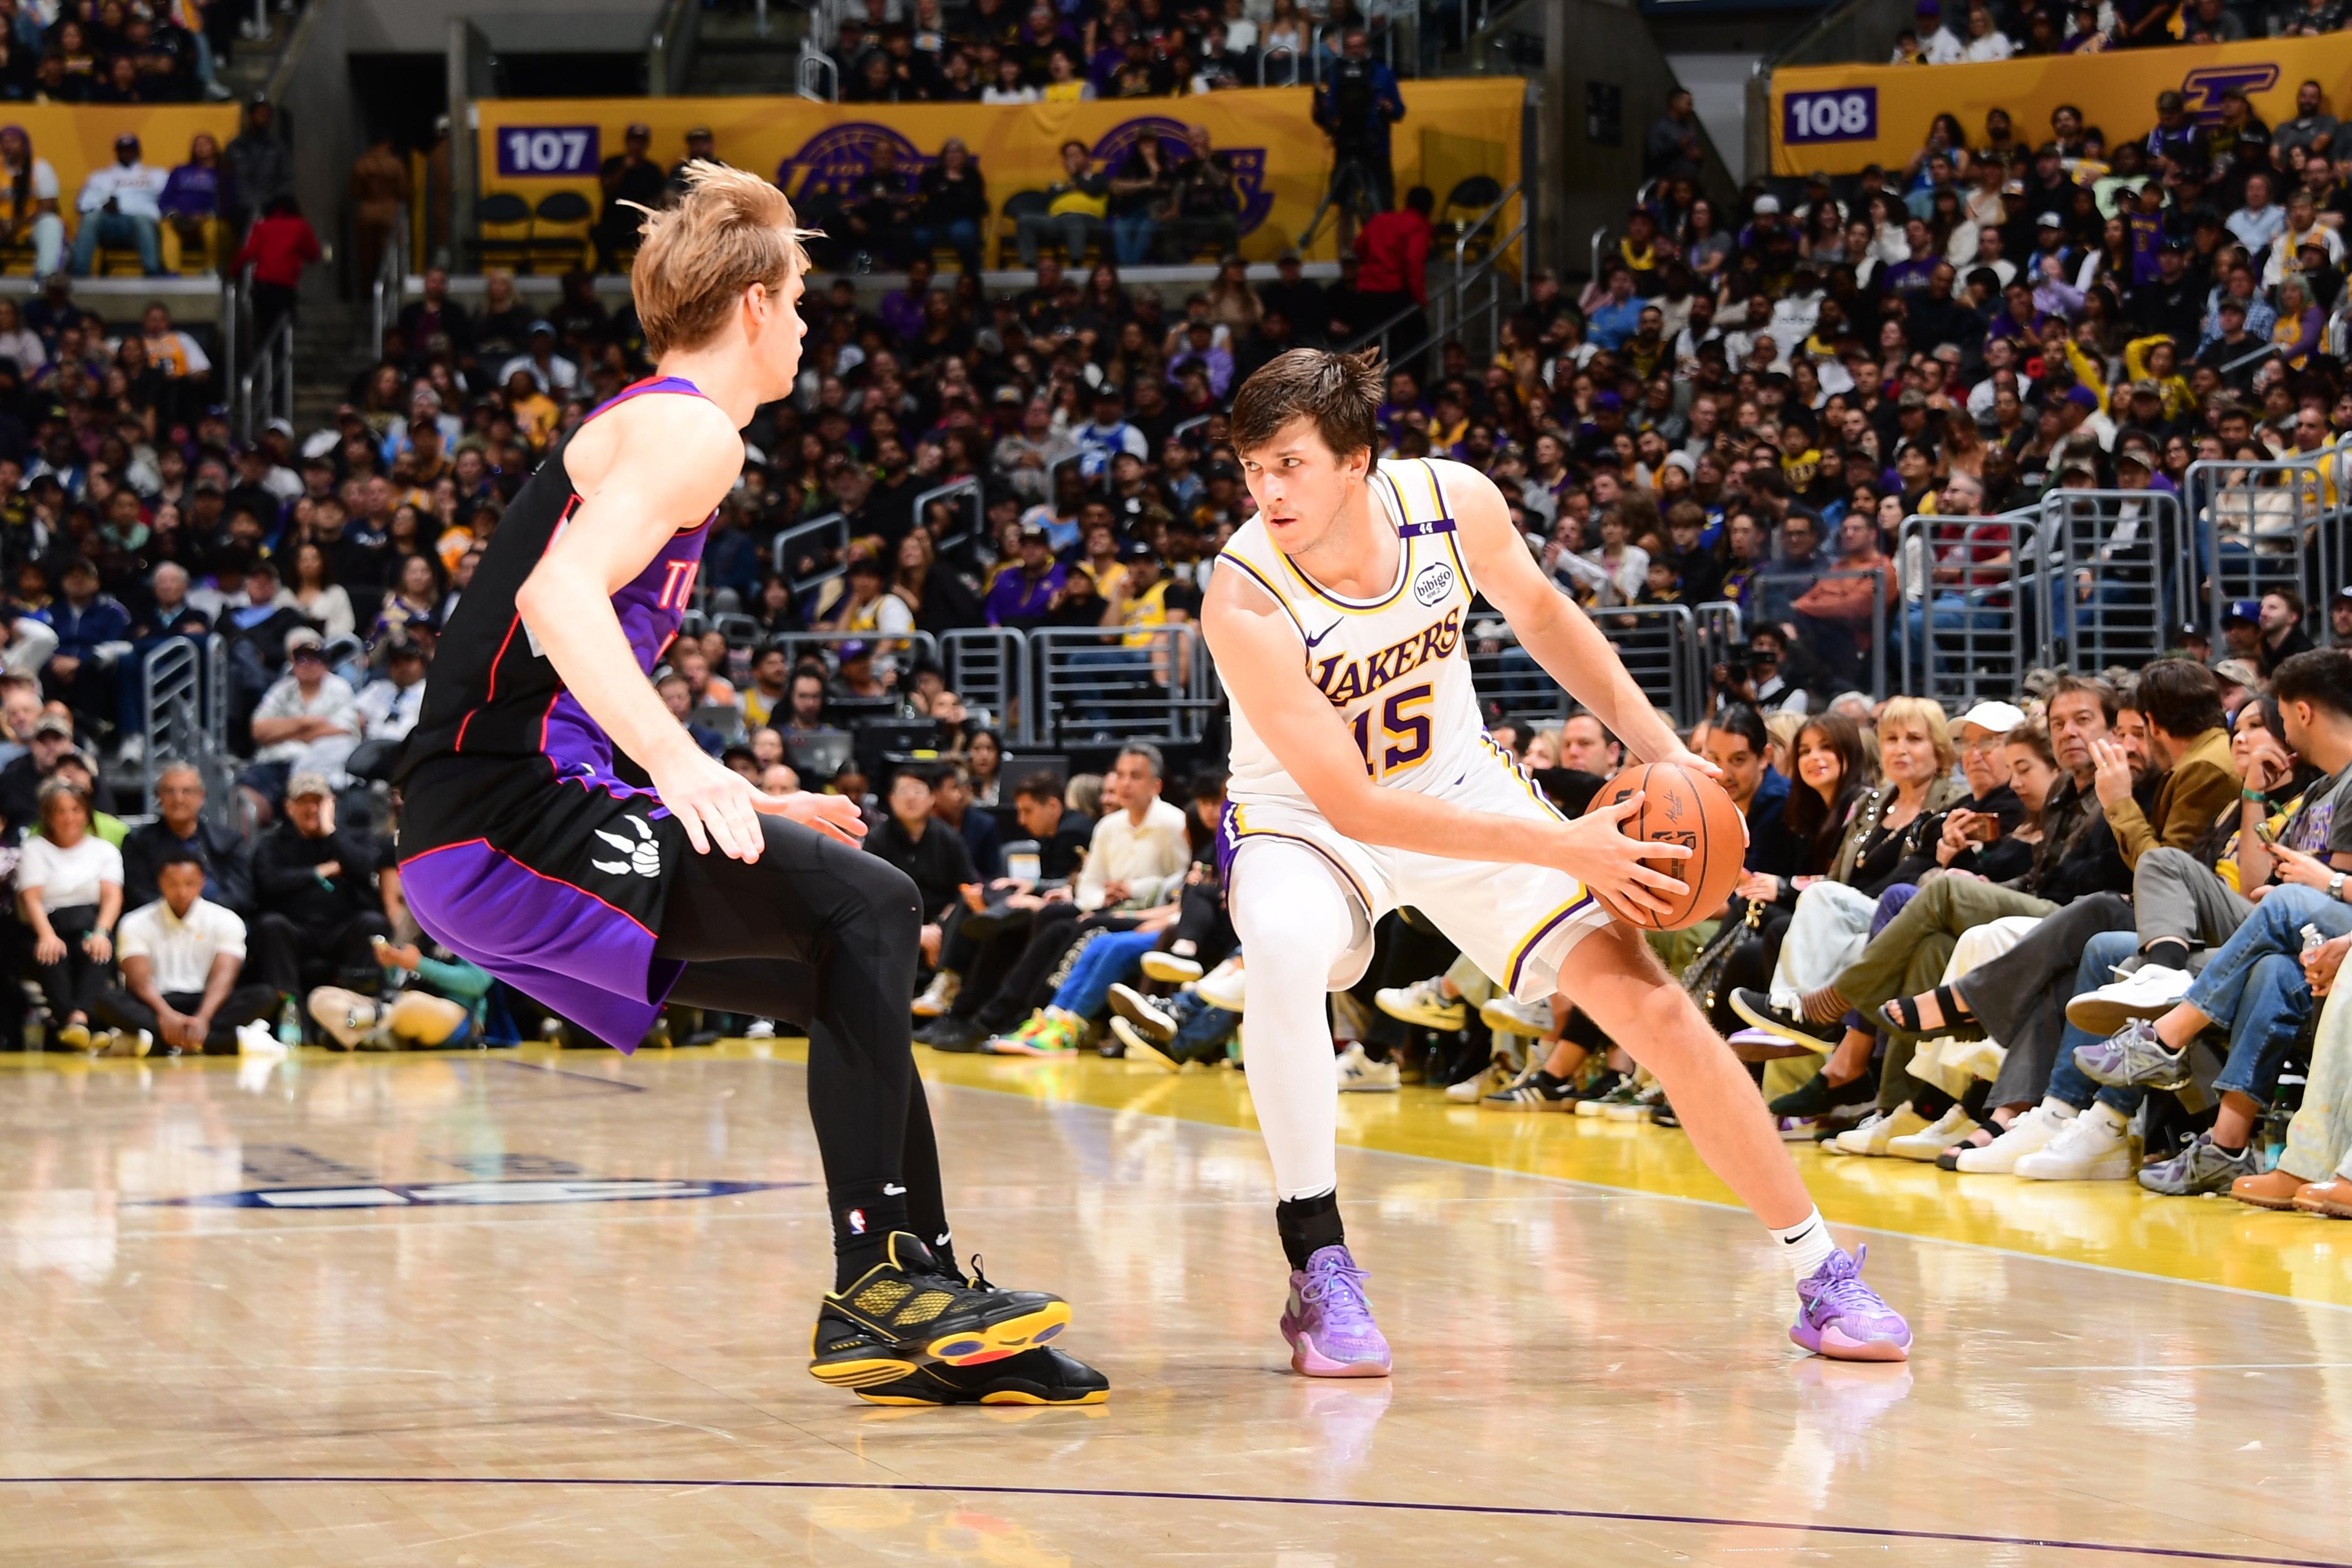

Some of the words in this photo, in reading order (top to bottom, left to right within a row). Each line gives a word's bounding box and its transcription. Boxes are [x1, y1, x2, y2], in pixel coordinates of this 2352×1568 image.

[1792, 96, 1868, 137] 108
[508, 132, 589, 170] 107
[1419, 522, 1433, 535] 44
[1417, 571, 1451, 597] bibigo
[1315, 605, 1461, 708] LAKERS
[1348, 681, 1434, 783] 15
